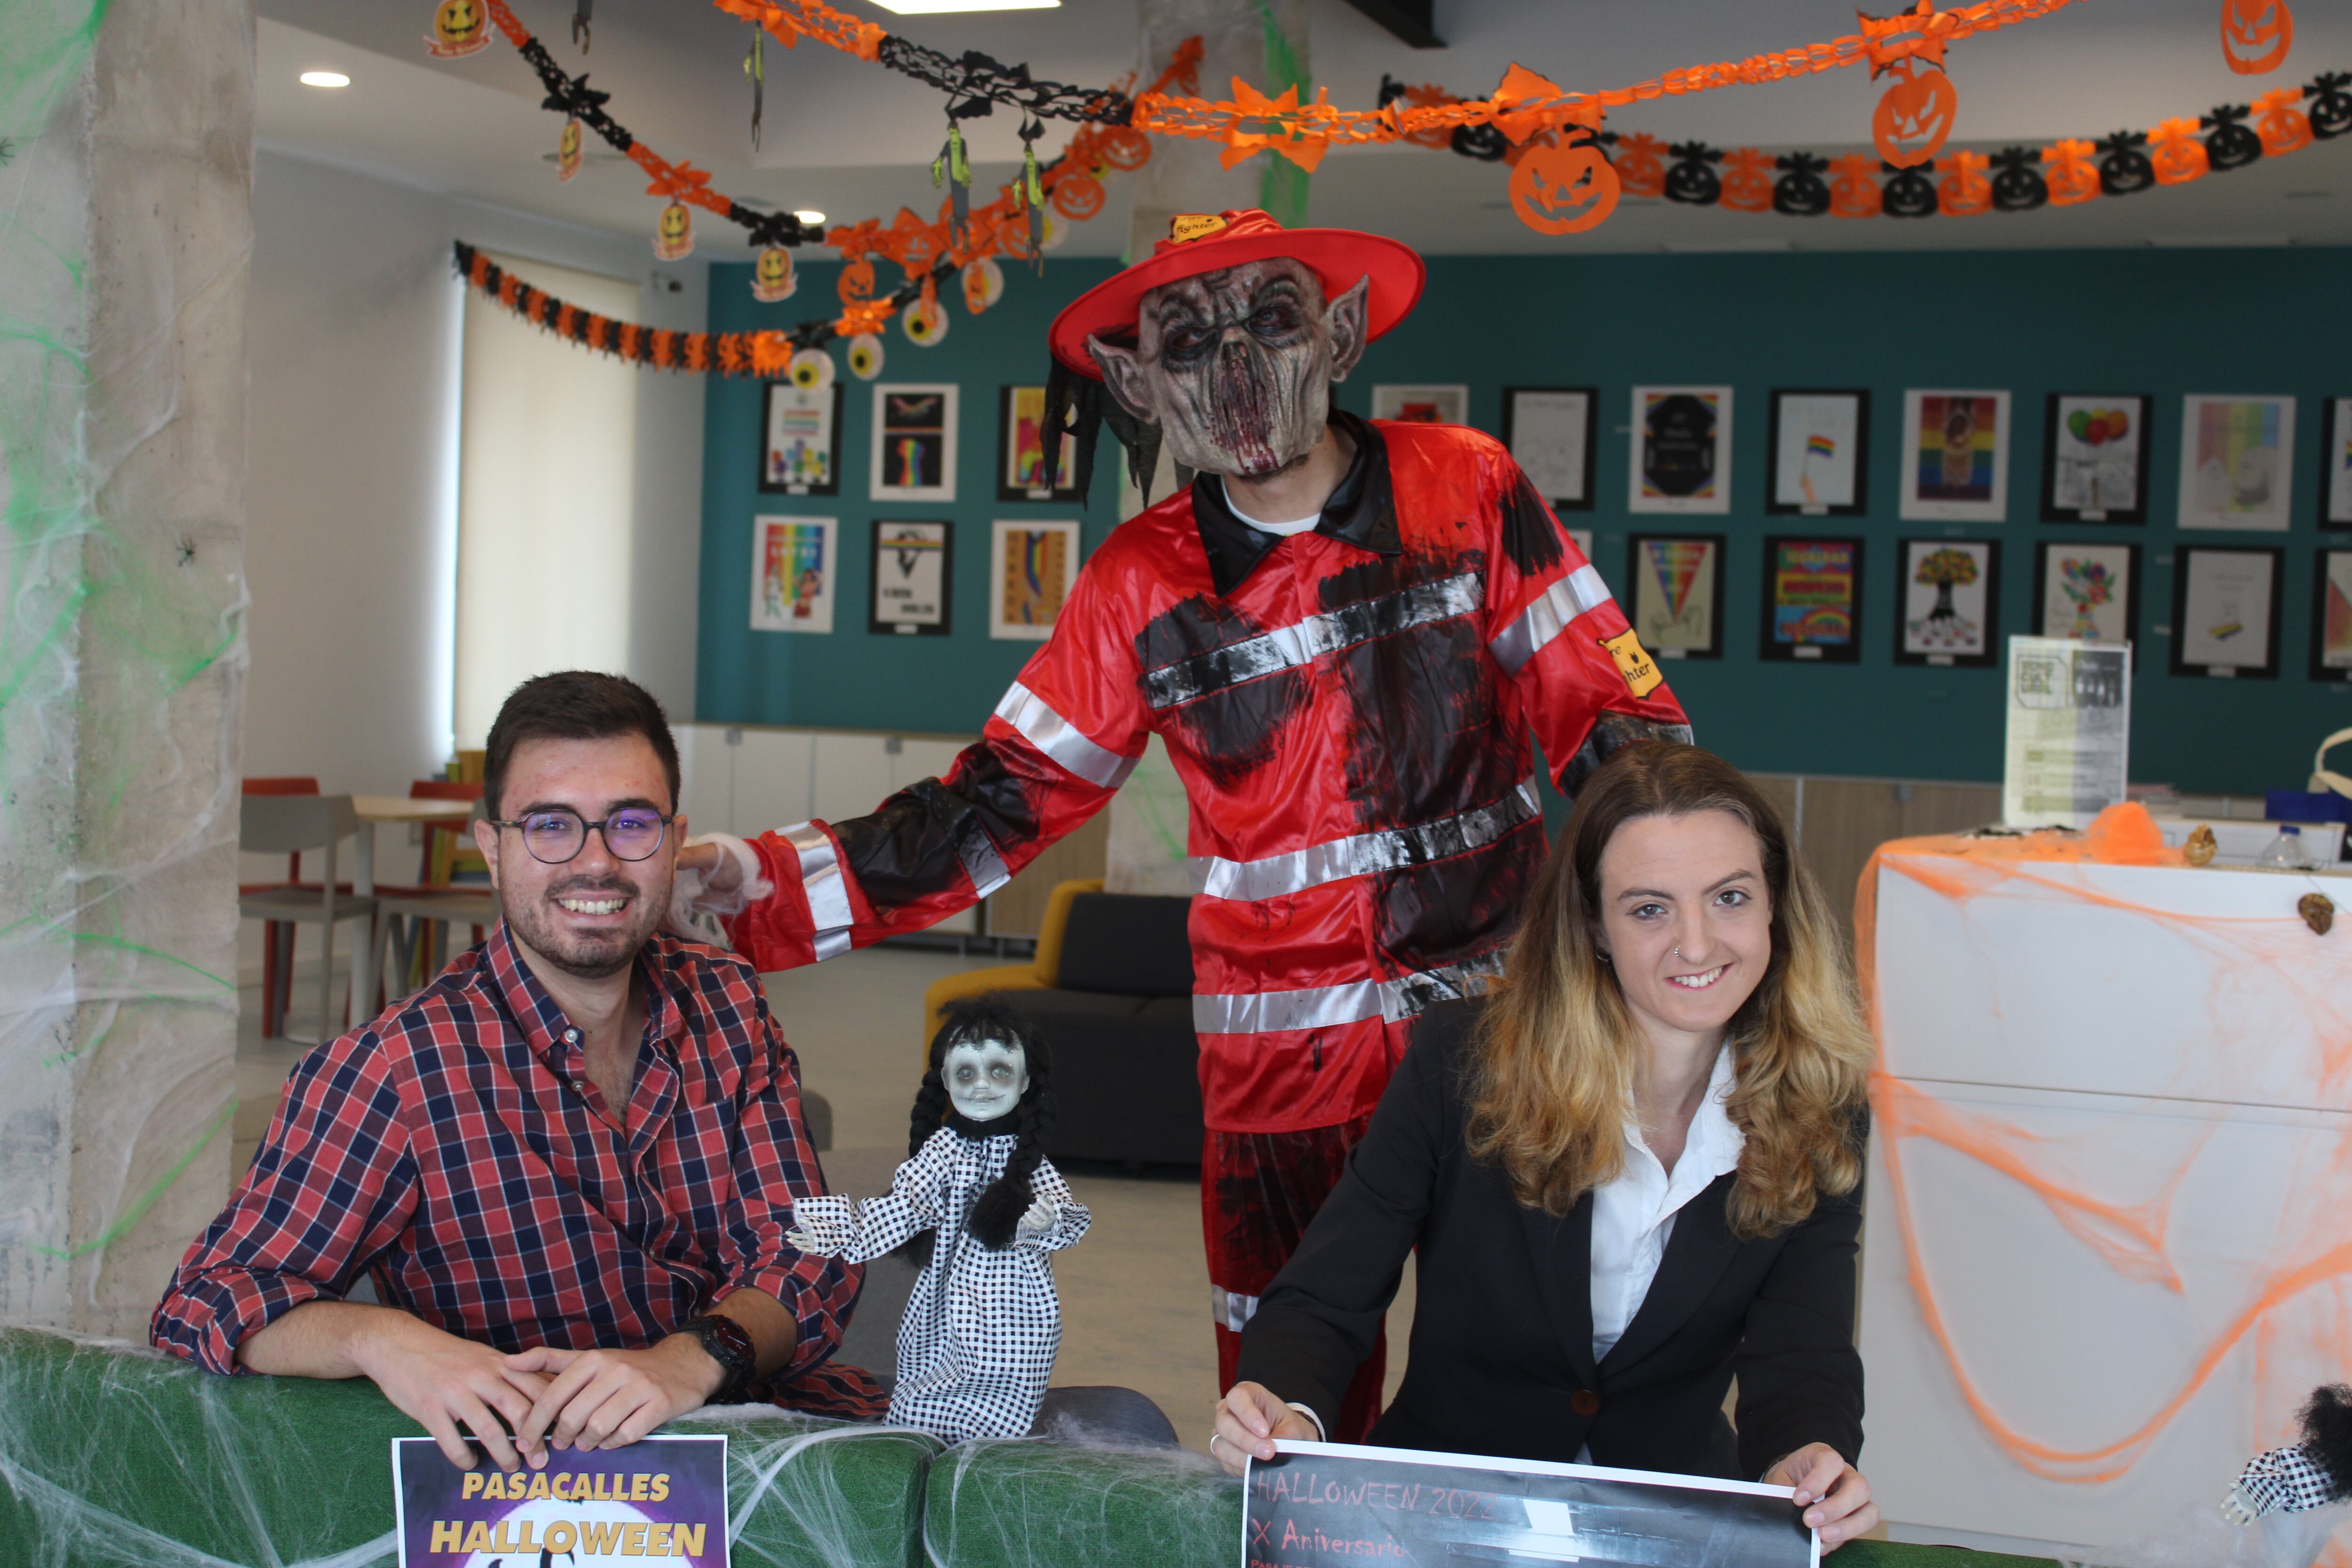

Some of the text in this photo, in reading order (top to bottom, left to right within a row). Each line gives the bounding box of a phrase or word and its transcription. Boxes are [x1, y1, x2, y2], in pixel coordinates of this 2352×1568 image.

[1177, 222, 1218, 239] fighter
[1623, 663, 1650, 684] hter
[462, 1472, 670, 1502] PASACALLES
[1258, 1471, 1498, 1520] HALLOWEEN 2022
[430, 1520, 706, 1557] HALLOWEEN
[1253, 1519, 1406, 1558] X Aniversario
